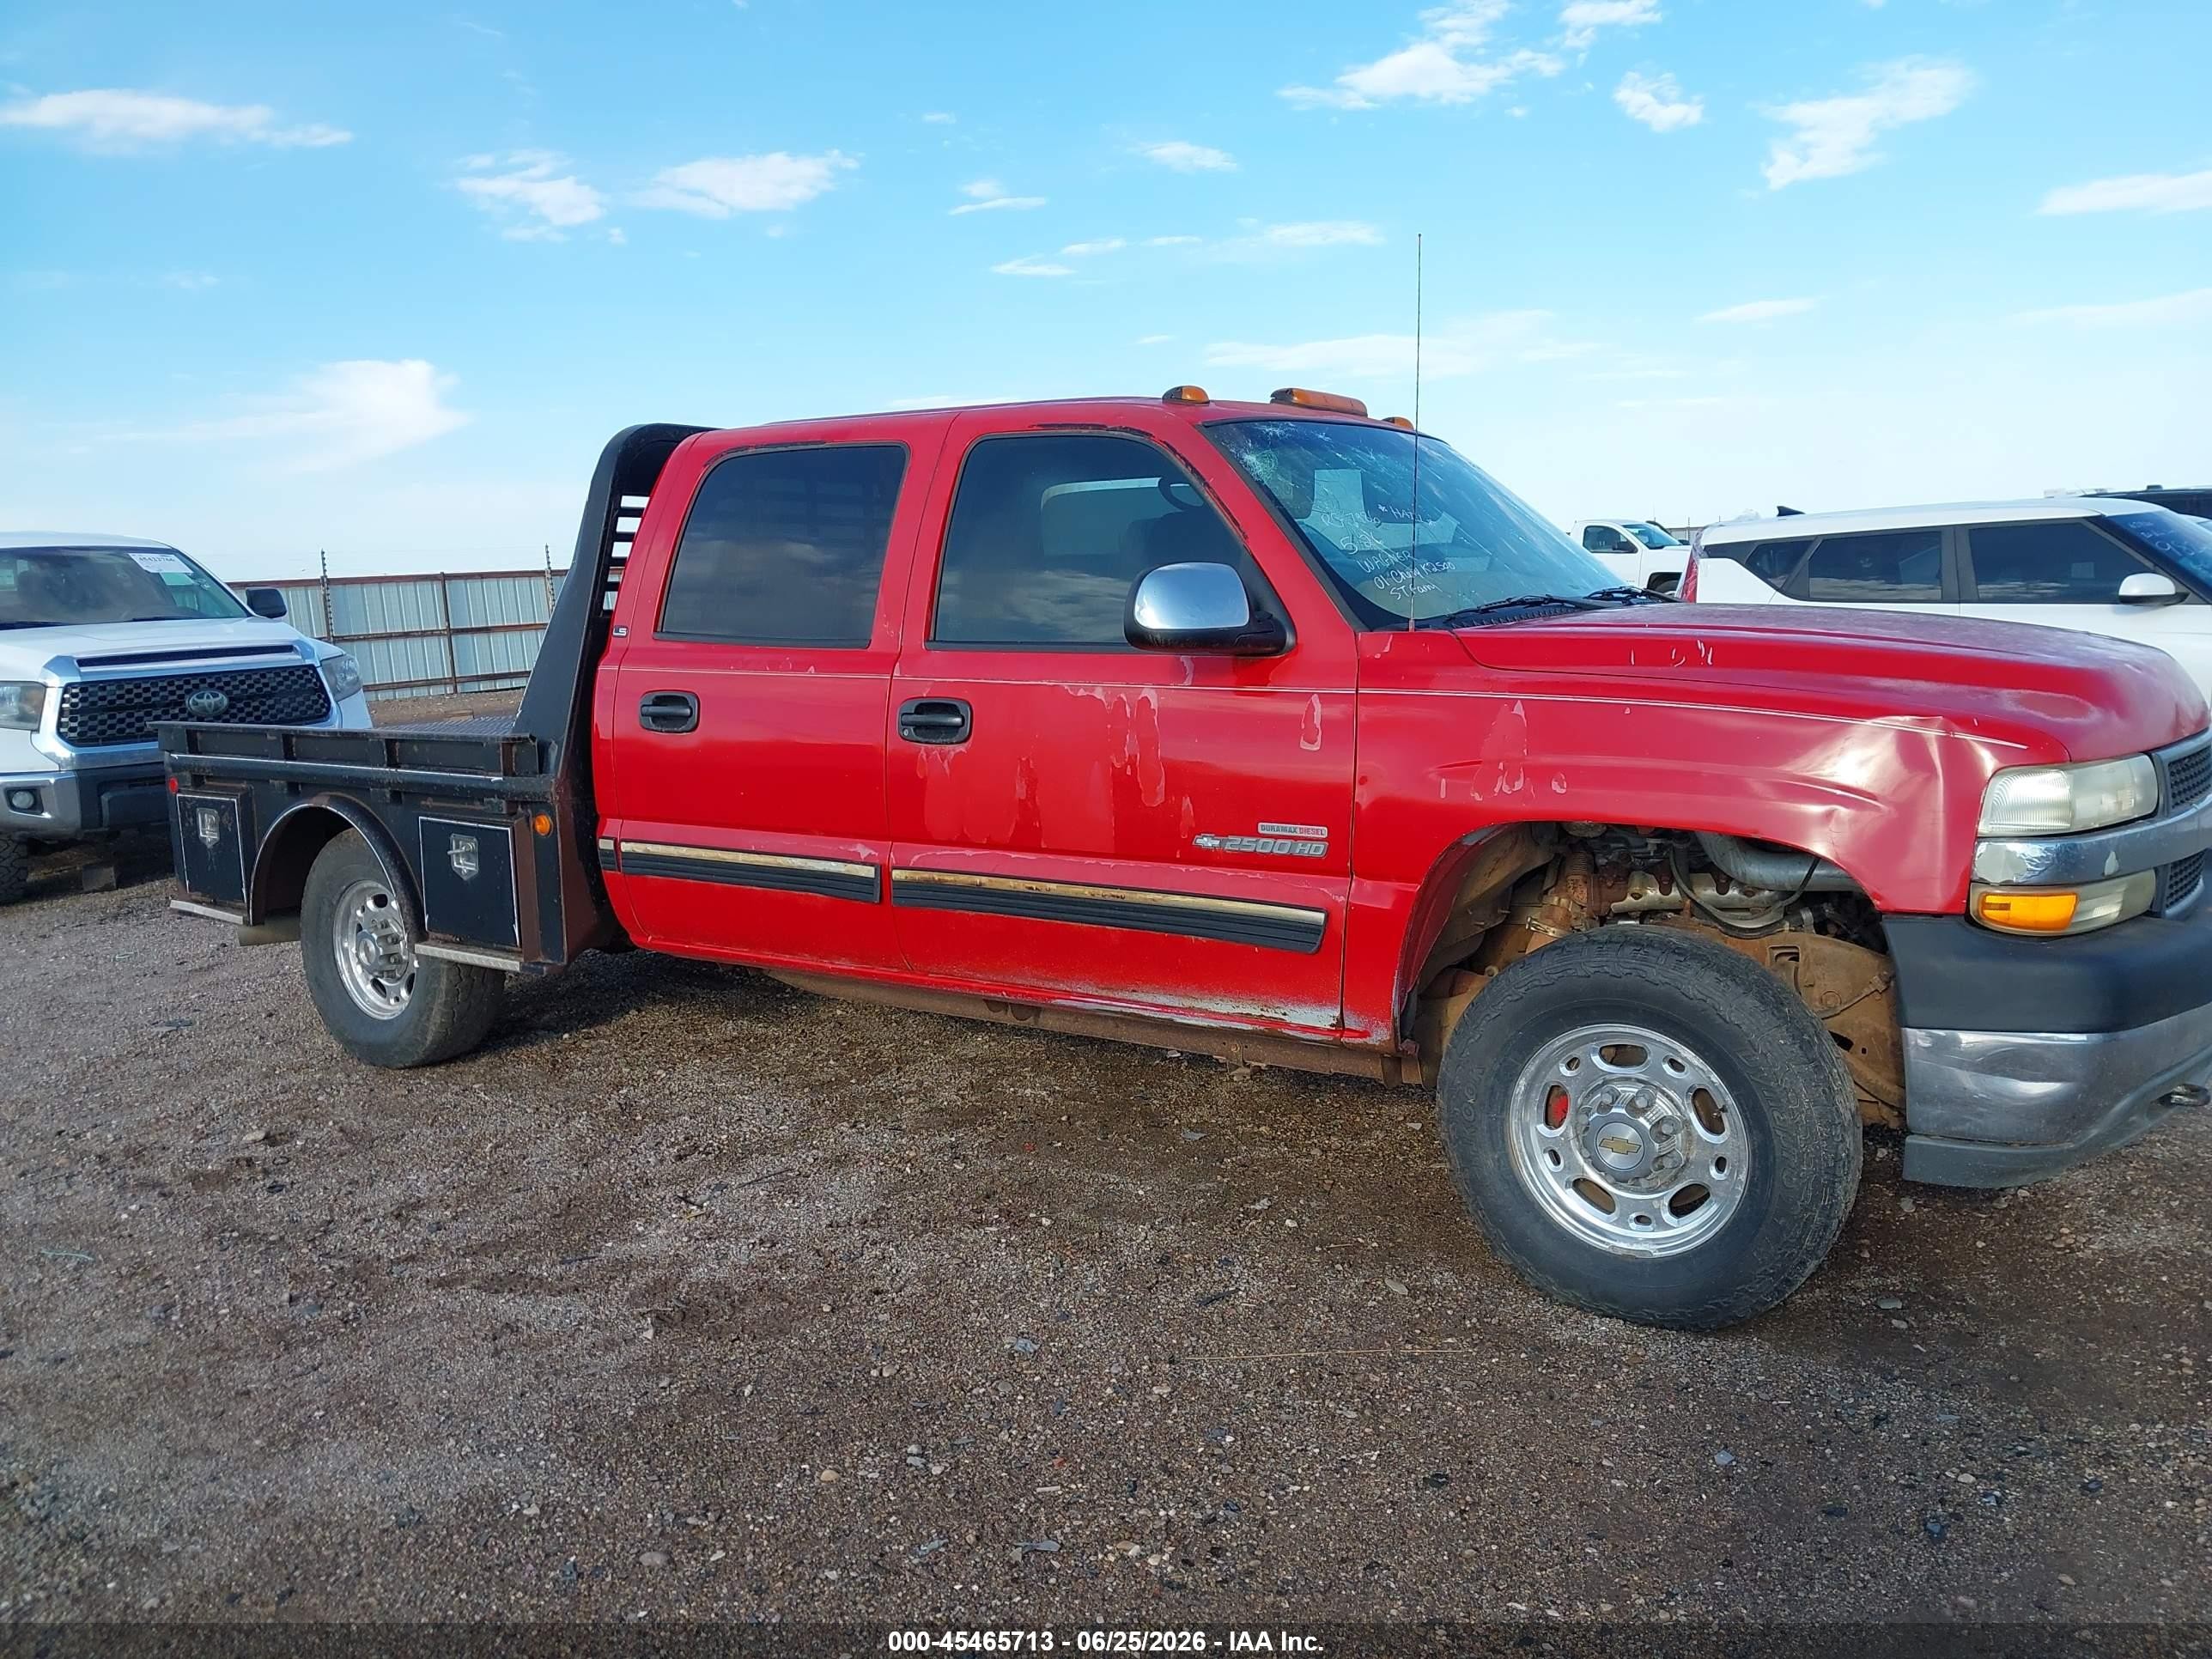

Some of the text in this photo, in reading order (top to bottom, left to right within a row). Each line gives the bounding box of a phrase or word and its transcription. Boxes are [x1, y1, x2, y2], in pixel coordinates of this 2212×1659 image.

[1374, 575, 1390, 589] 01
[612, 628, 627, 636] LS
[1261, 823, 1326, 836] DURAMAX DIESEL
[1224, 836, 1326, 855] 2500 HD
